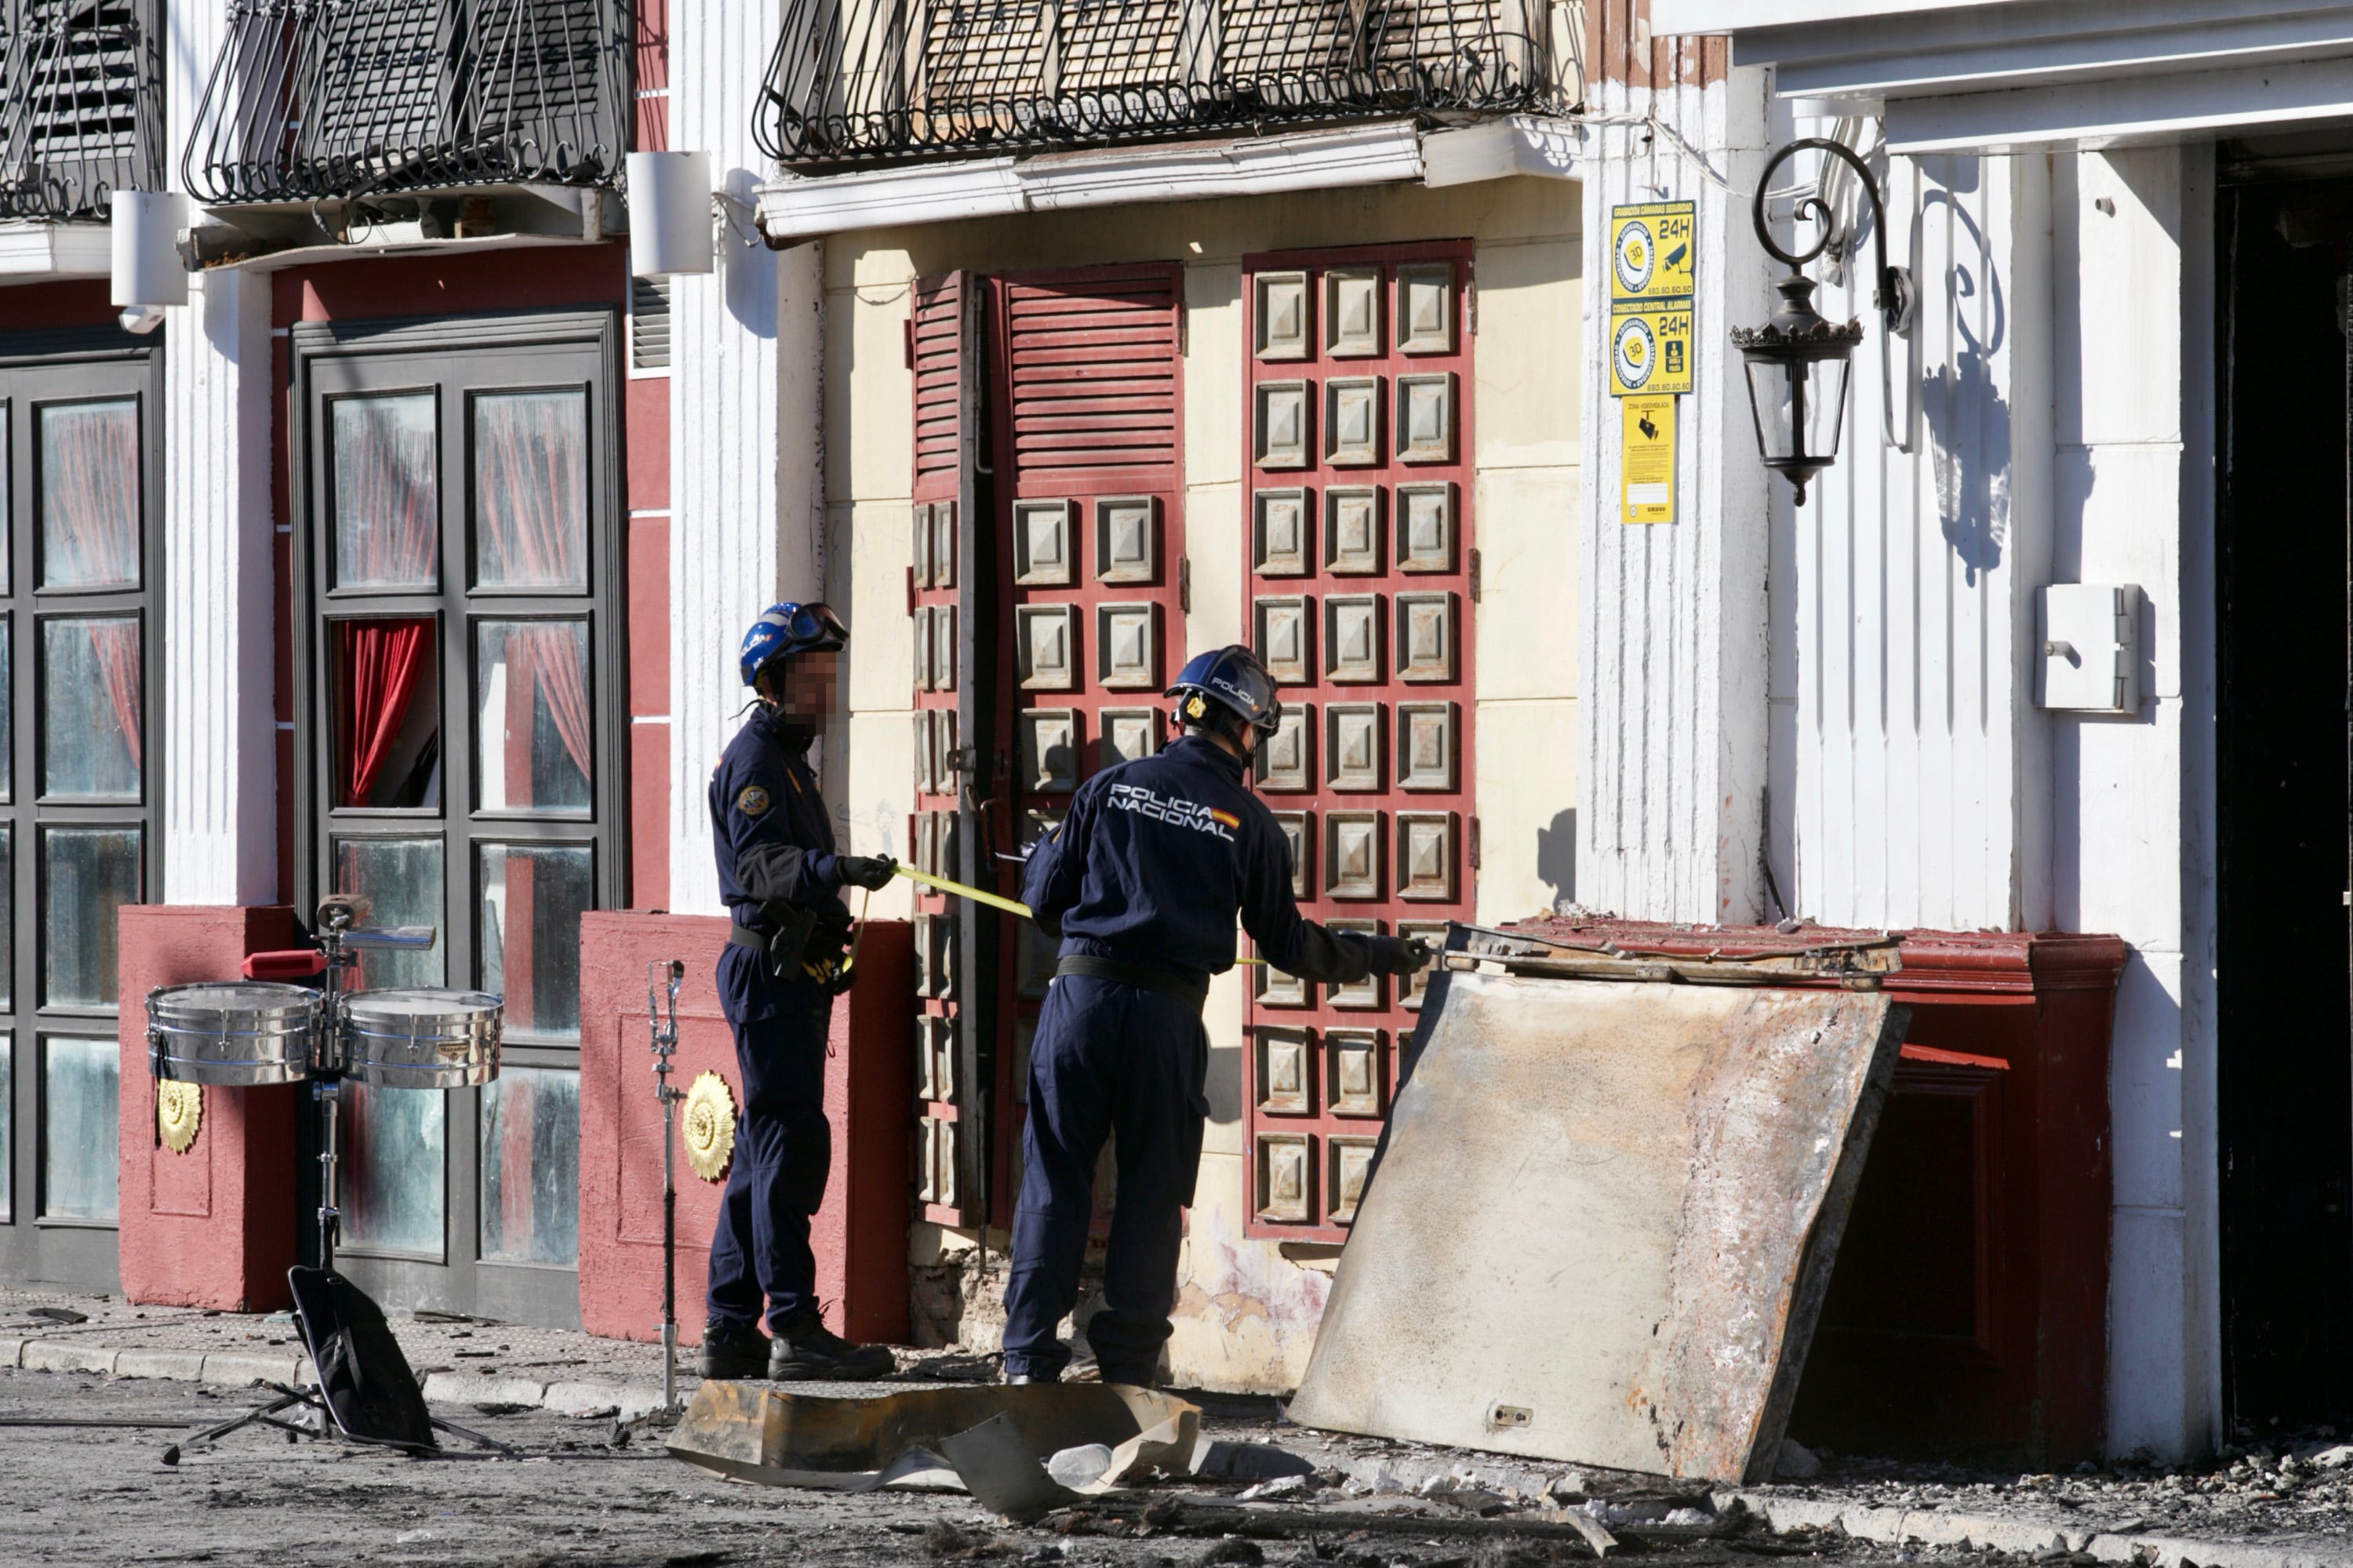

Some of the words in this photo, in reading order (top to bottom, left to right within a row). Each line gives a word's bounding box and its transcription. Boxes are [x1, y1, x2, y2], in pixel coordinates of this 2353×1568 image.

[1659, 218, 1689, 239] 24H
[1630, 246, 1643, 261] 3D
[1644, 301, 1666, 311] CENTRAL
[1659, 315, 1689, 336] 24H
[1629, 342, 1642, 357] 3D
[1110, 784, 1213, 820] POLICIA
[1107, 796, 1235, 842] NACIONAL
